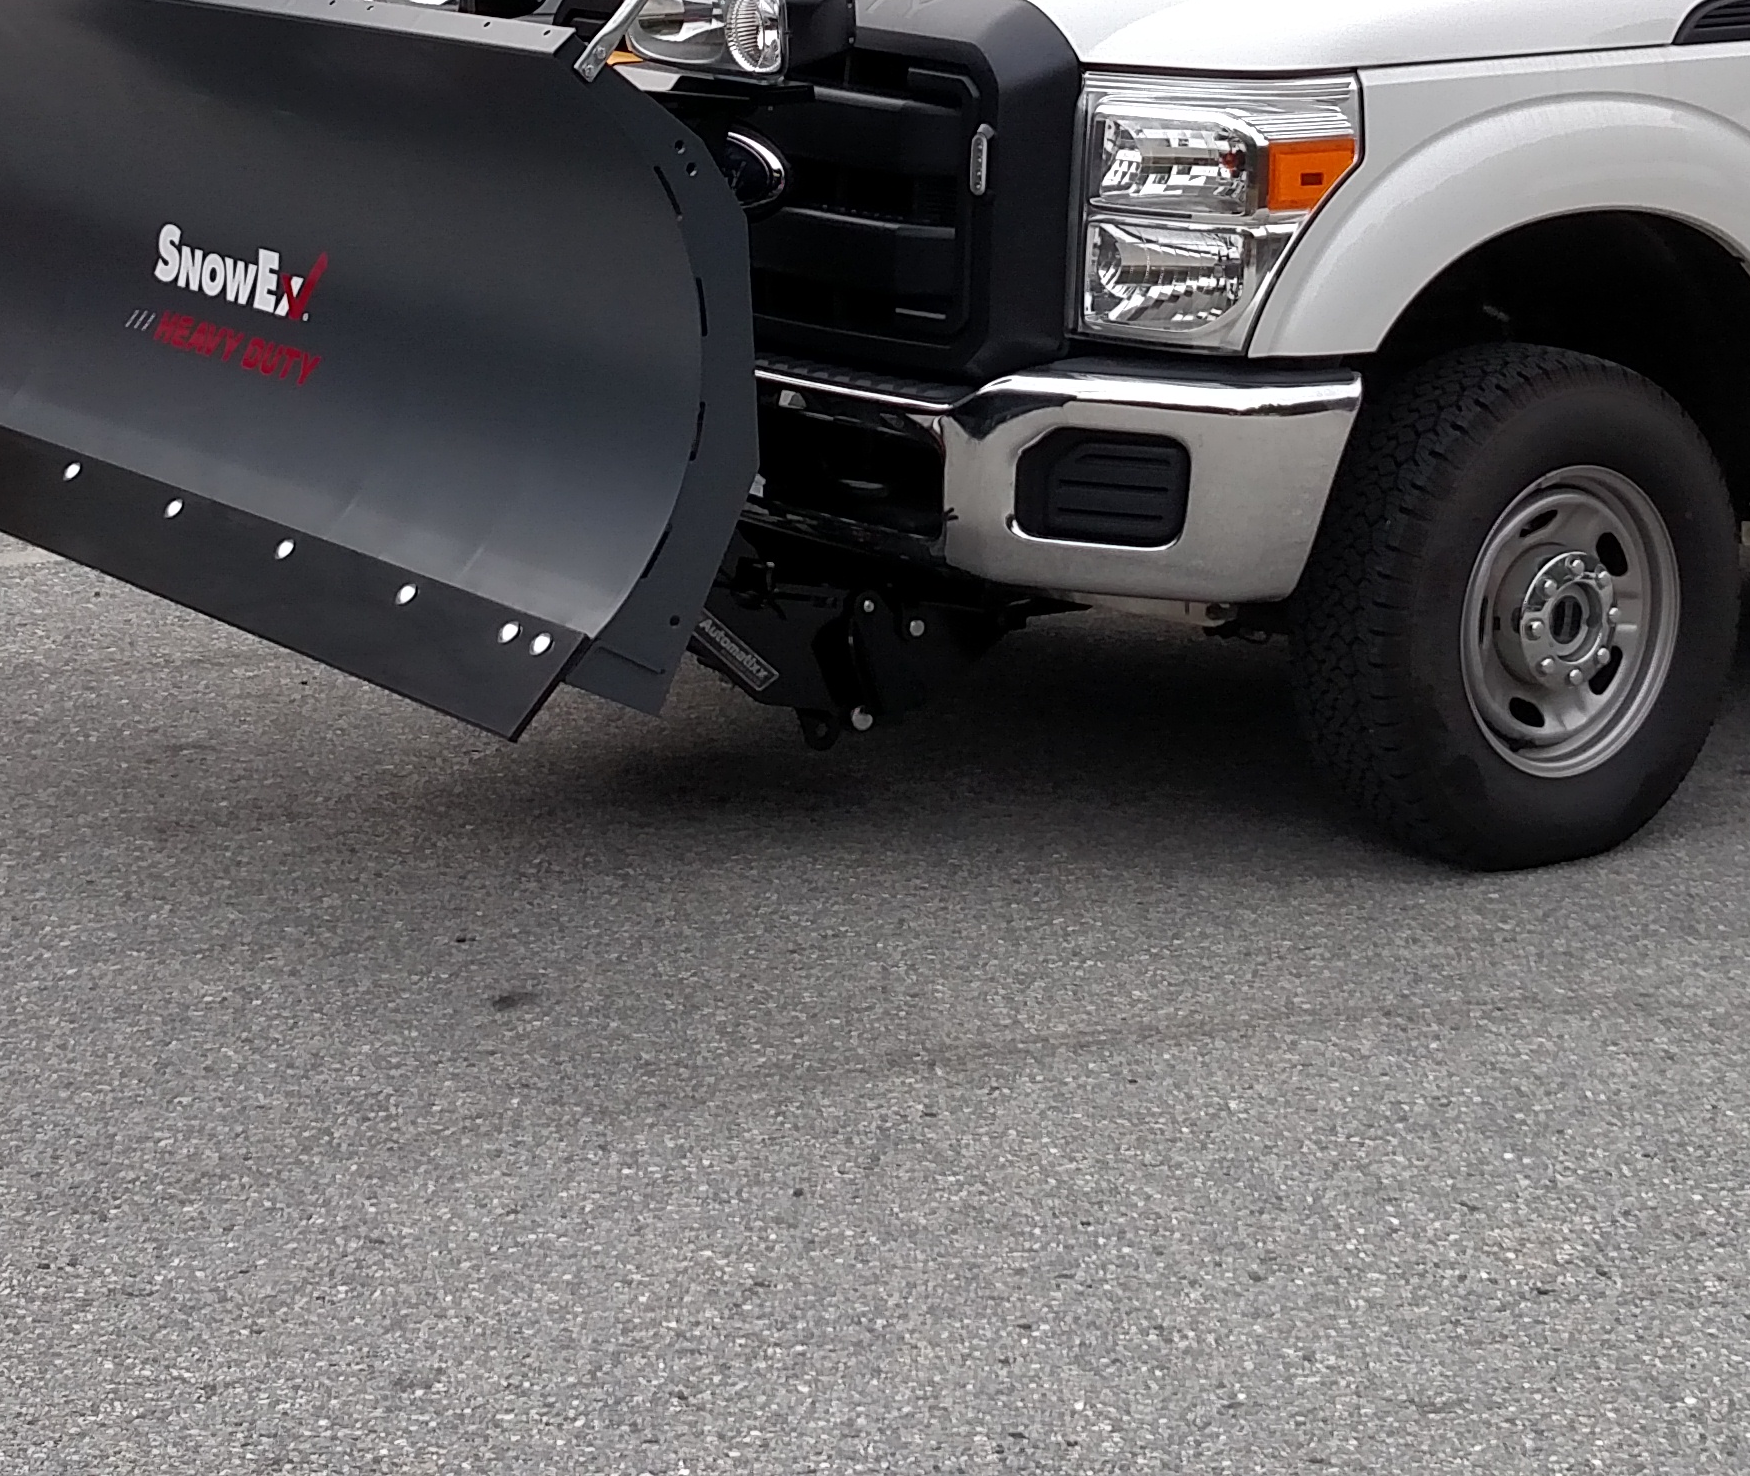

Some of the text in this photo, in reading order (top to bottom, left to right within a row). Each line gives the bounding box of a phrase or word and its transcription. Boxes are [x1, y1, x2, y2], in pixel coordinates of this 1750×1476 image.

[153, 310, 322, 386] HEAVY DUTY
[699, 618, 769, 679] Automatixx
